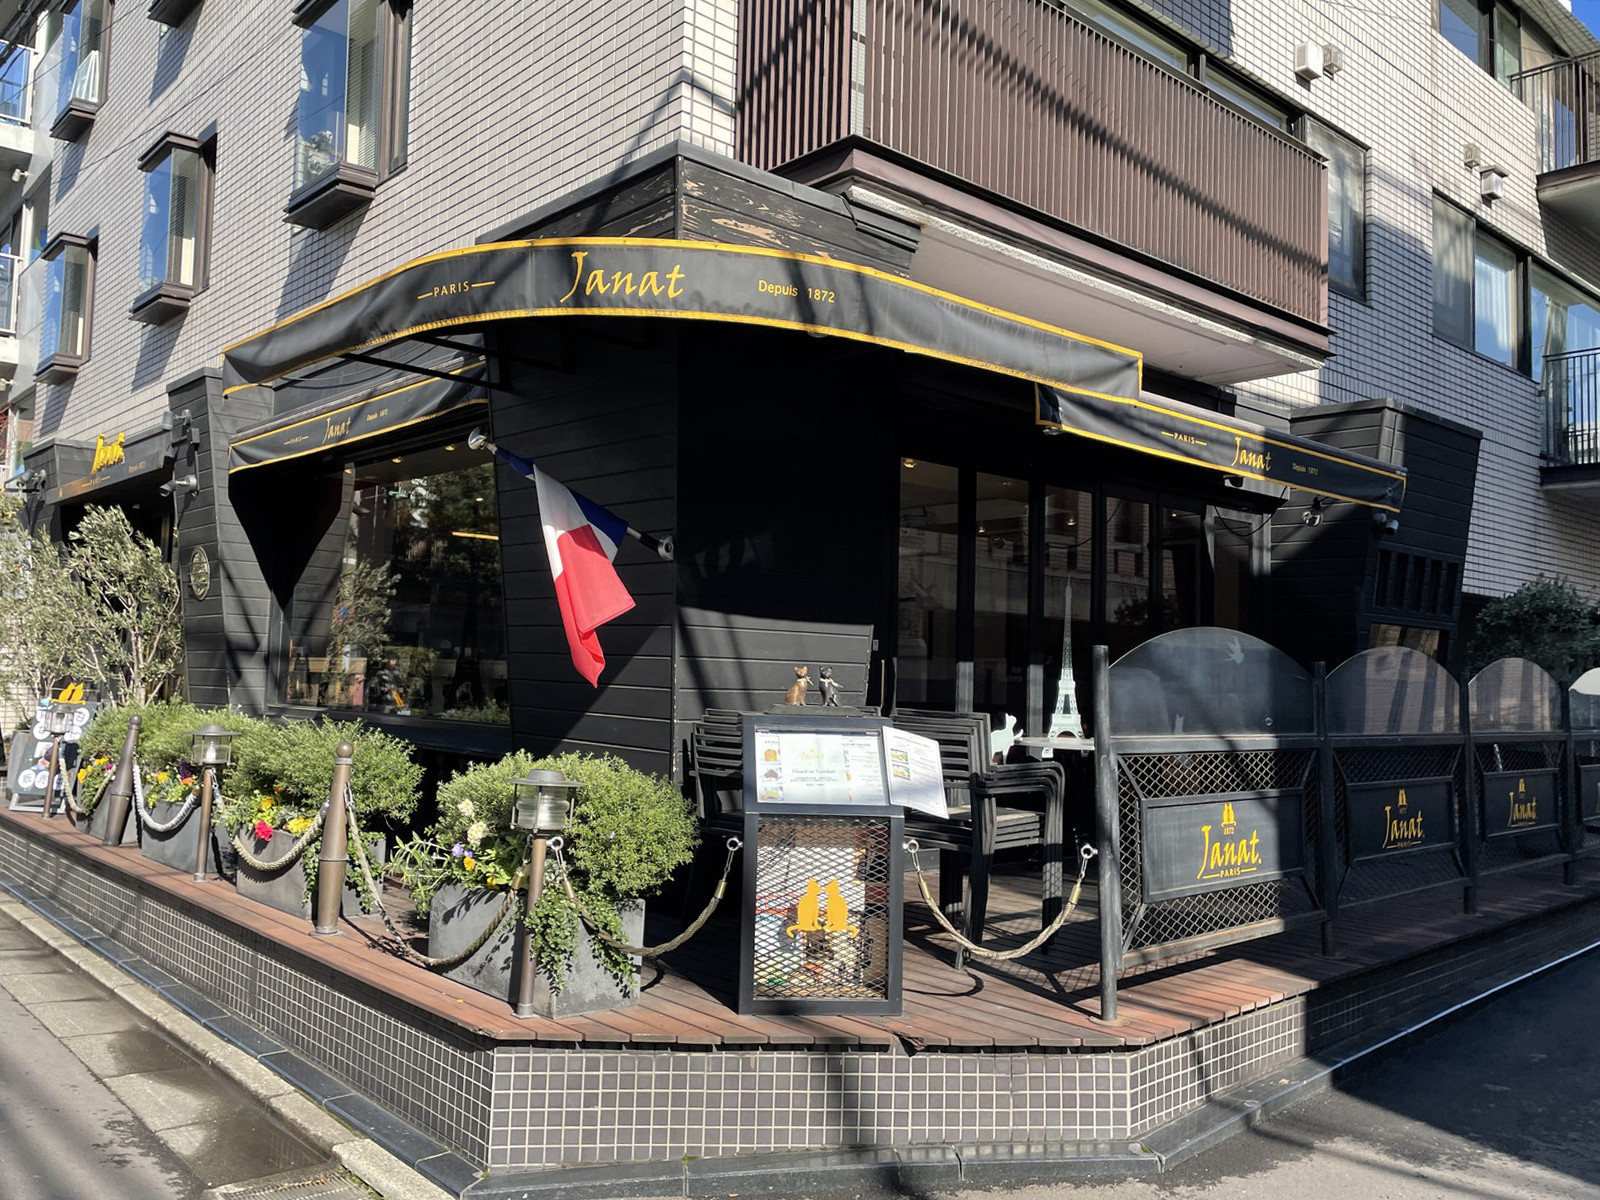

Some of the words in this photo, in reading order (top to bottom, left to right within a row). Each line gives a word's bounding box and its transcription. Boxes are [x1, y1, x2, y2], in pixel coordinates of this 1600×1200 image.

[433, 281, 470, 297] PARIS
[560, 251, 685, 303] Janat
[758, 279, 798, 297] Depuis
[807, 287, 835, 304] 1872
[322, 417, 351, 444] Janat
[1173, 432, 1195, 444] PARIS
[1231, 437, 1272, 472] Janat
[1220, 867, 1241, 878] PARIS
